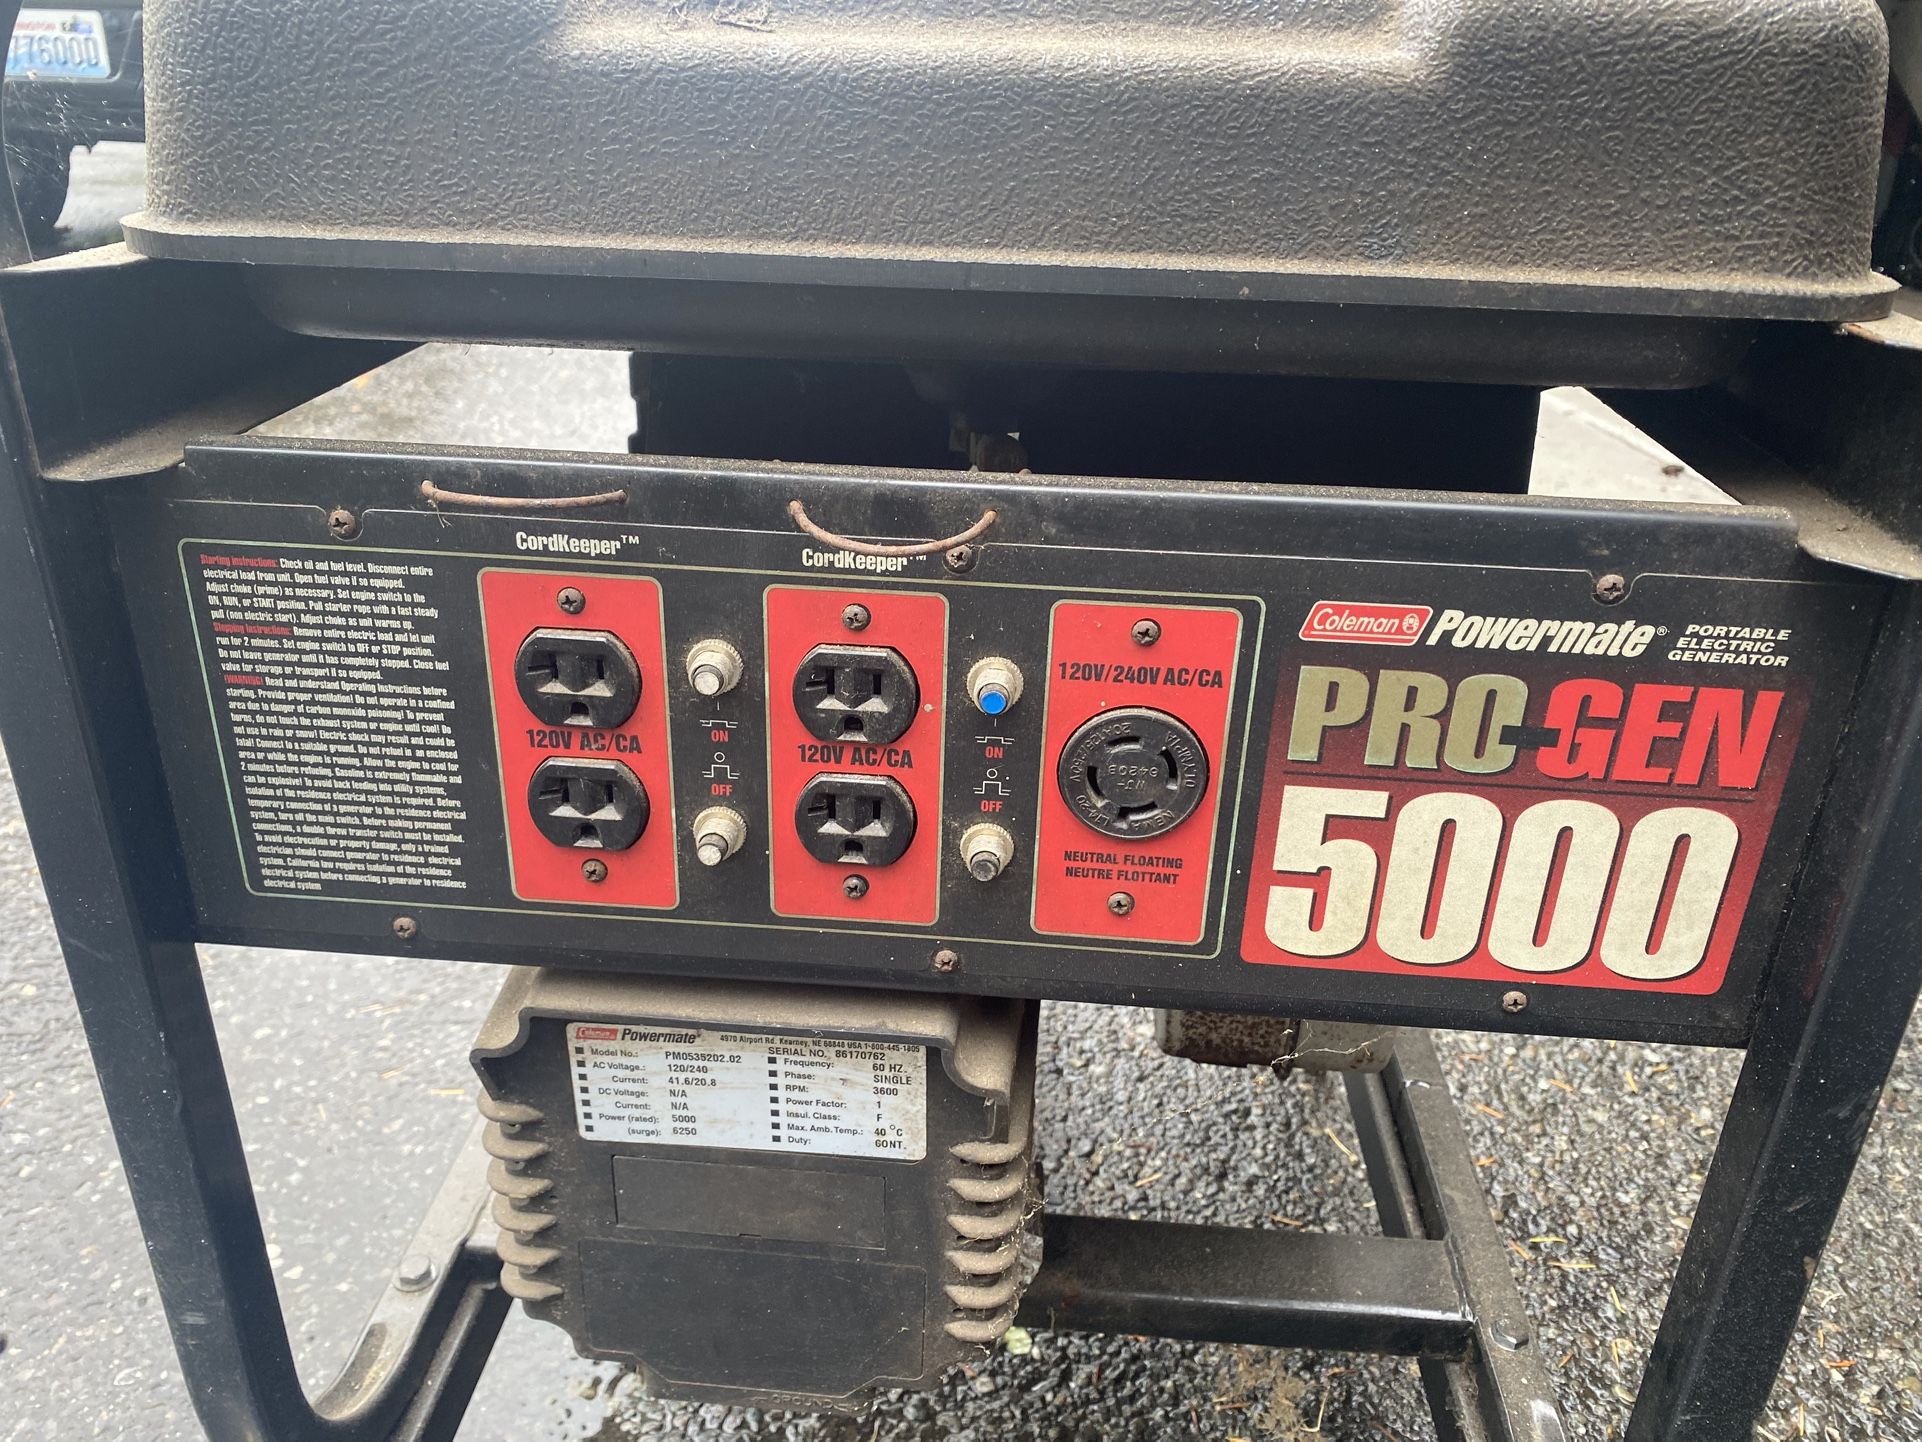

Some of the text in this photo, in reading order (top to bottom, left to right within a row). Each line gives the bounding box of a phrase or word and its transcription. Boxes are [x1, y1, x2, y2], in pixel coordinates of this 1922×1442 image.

[279, 558, 302, 568] Check
[304, 559, 313, 569] oil
[314, 560, 328, 570] and
[329, 560, 344, 571] fuel
[345, 561, 366, 572] level.
[367, 562, 408, 574] Disconnect
[410, 565, 433, 576] entire
[202, 568, 404, 588] electrical load from unit. Open fuel valve if so equipped.
[206, 581, 425, 602] Adjust choke (prime) as necessary. Set engine switch to the
[207, 594, 438, 618] ON, RUN, or START position. Pull starter rope with a fast steady
[210, 608, 414, 630] pull (non electric start). Adjust choke as unit warms up.
[292, 626, 322, 637] Remove
[323, 628, 345, 638] entire
[346, 629, 376, 640] electric
[376, 630, 393, 641] load
[394, 632, 408, 641] and
[408, 632, 419, 642] let
[420, 633, 435, 643] unit
[1313, 608, 1668, 658] Coleman Powermate®
[1686, 624, 1792, 640] PORTABLE
[1676, 638, 1775, 652] ELECTRIC
[1668, 651, 1789, 667] GENERATOR
[220, 661, 240, 671] valve
[241, 662, 253, 671] for
[254, 663, 282, 674] storage
[294, 665, 329, 676] transport
[330, 667, 336, 676] if
[348, 668, 382, 680] equipped.
[1059, 662, 1223, 688] 120V/240V AC/CA
[1287, 665, 1784, 788] PRO-GEN
[526, 729, 642, 753] 120V AC/CA
[711, 731, 728, 742] ON
[798, 744, 913, 769] 120V AC/CA
[986, 746, 1003, 758] ON
[711, 784, 732, 796] OFF
[981, 801, 1003, 812] OFF
[1064, 851, 1182, 868] NEUTRAL FLOATING
[1066, 867, 1179, 884] NEUTRE FLOTTANT
[1264, 785, 1739, 981] 5000
[739, 1036, 763, 1045] Airport
[591, 1048, 617, 1056] Model
[665, 1051, 742, 1063] PM0535202.02
[769, 1047, 885, 1061] SERIAL NO. 86170762
[668, 1064, 708, 1074] 120/240
[784, 1059, 907, 1073] Frequency: 60 HZ.
[612, 1076, 717, 1086] Current: 41.6/20.8
[784, 1072, 912, 1085] Phase: SINGLE
[613, 1089, 648, 1098] Voltage:
[670, 1090, 687, 1098] N/A
[786, 1085, 898, 1096] RPM: 3600
[615, 1101, 689, 1111] Current: N/A
[786, 1098, 813, 1106] Power
[816, 1100, 847, 1108] Factor:
[628, 1114, 660, 1124] (rated):
[672, 1115, 696, 1123] 5000
[786, 1111, 811, 1119] Insul.
[813, 1112, 840, 1121] Class:
[628, 1127, 697, 1137] (surge): 6250
[835, 1127, 863, 1136] Temp.:
[874, 1128, 886, 1136] 40
[788, 1136, 811, 1145] Duty:
